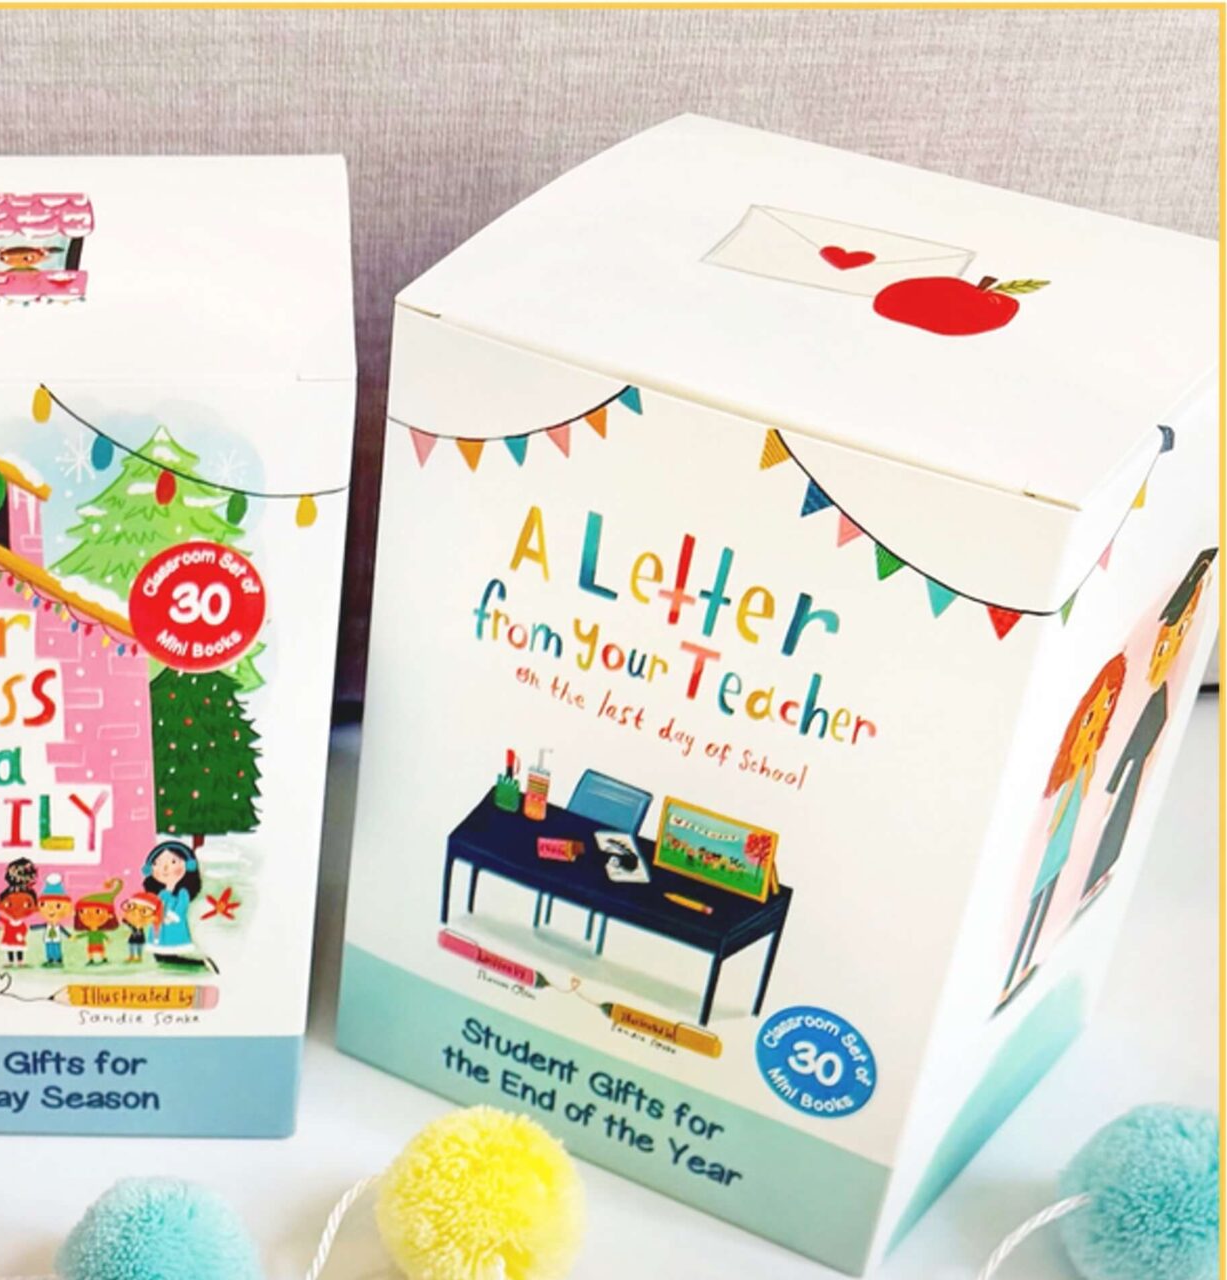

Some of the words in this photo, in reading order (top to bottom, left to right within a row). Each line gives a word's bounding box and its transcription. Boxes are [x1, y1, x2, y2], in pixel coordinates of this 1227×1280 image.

[143, 549, 216, 597] Classroom
[218, 553, 248, 578] Set
[241, 577, 261, 594] of
[510, 506, 550, 581] A
[578, 511, 840, 656] Letter
[169, 582, 231, 625] 30
[156, 629, 188, 657] Mini
[192, 630, 242, 658] Books
[474, 578, 563, 658] from
[680, 641, 877, 745] Teacher
[516, 666, 541, 690] on
[551, 676, 585, 710] the
[598, 689, 645, 730] last
[659, 717, 695, 757] day
[705, 742, 732, 765] of
[739, 749, 809, 790] School
[80, 986, 171, 1005] Illustrated
[179, 988, 196, 1006] by
[3, 1050, 85, 1076] Gifts
[95, 1050, 148, 1076] for
[462, 1017, 578, 1084] Student
[589, 1071, 664, 1120] Gifts
[674, 1102, 725, 1141] for
[787, 1040, 843, 1087] 30
[40, 1085, 160, 1110] Season
[442, 1045, 491, 1084] the
[501, 1069, 557, 1112] End
[565, 1101, 597, 1127] of
[603, 1115, 655, 1153] the
[669, 1136, 743, 1188] Year
